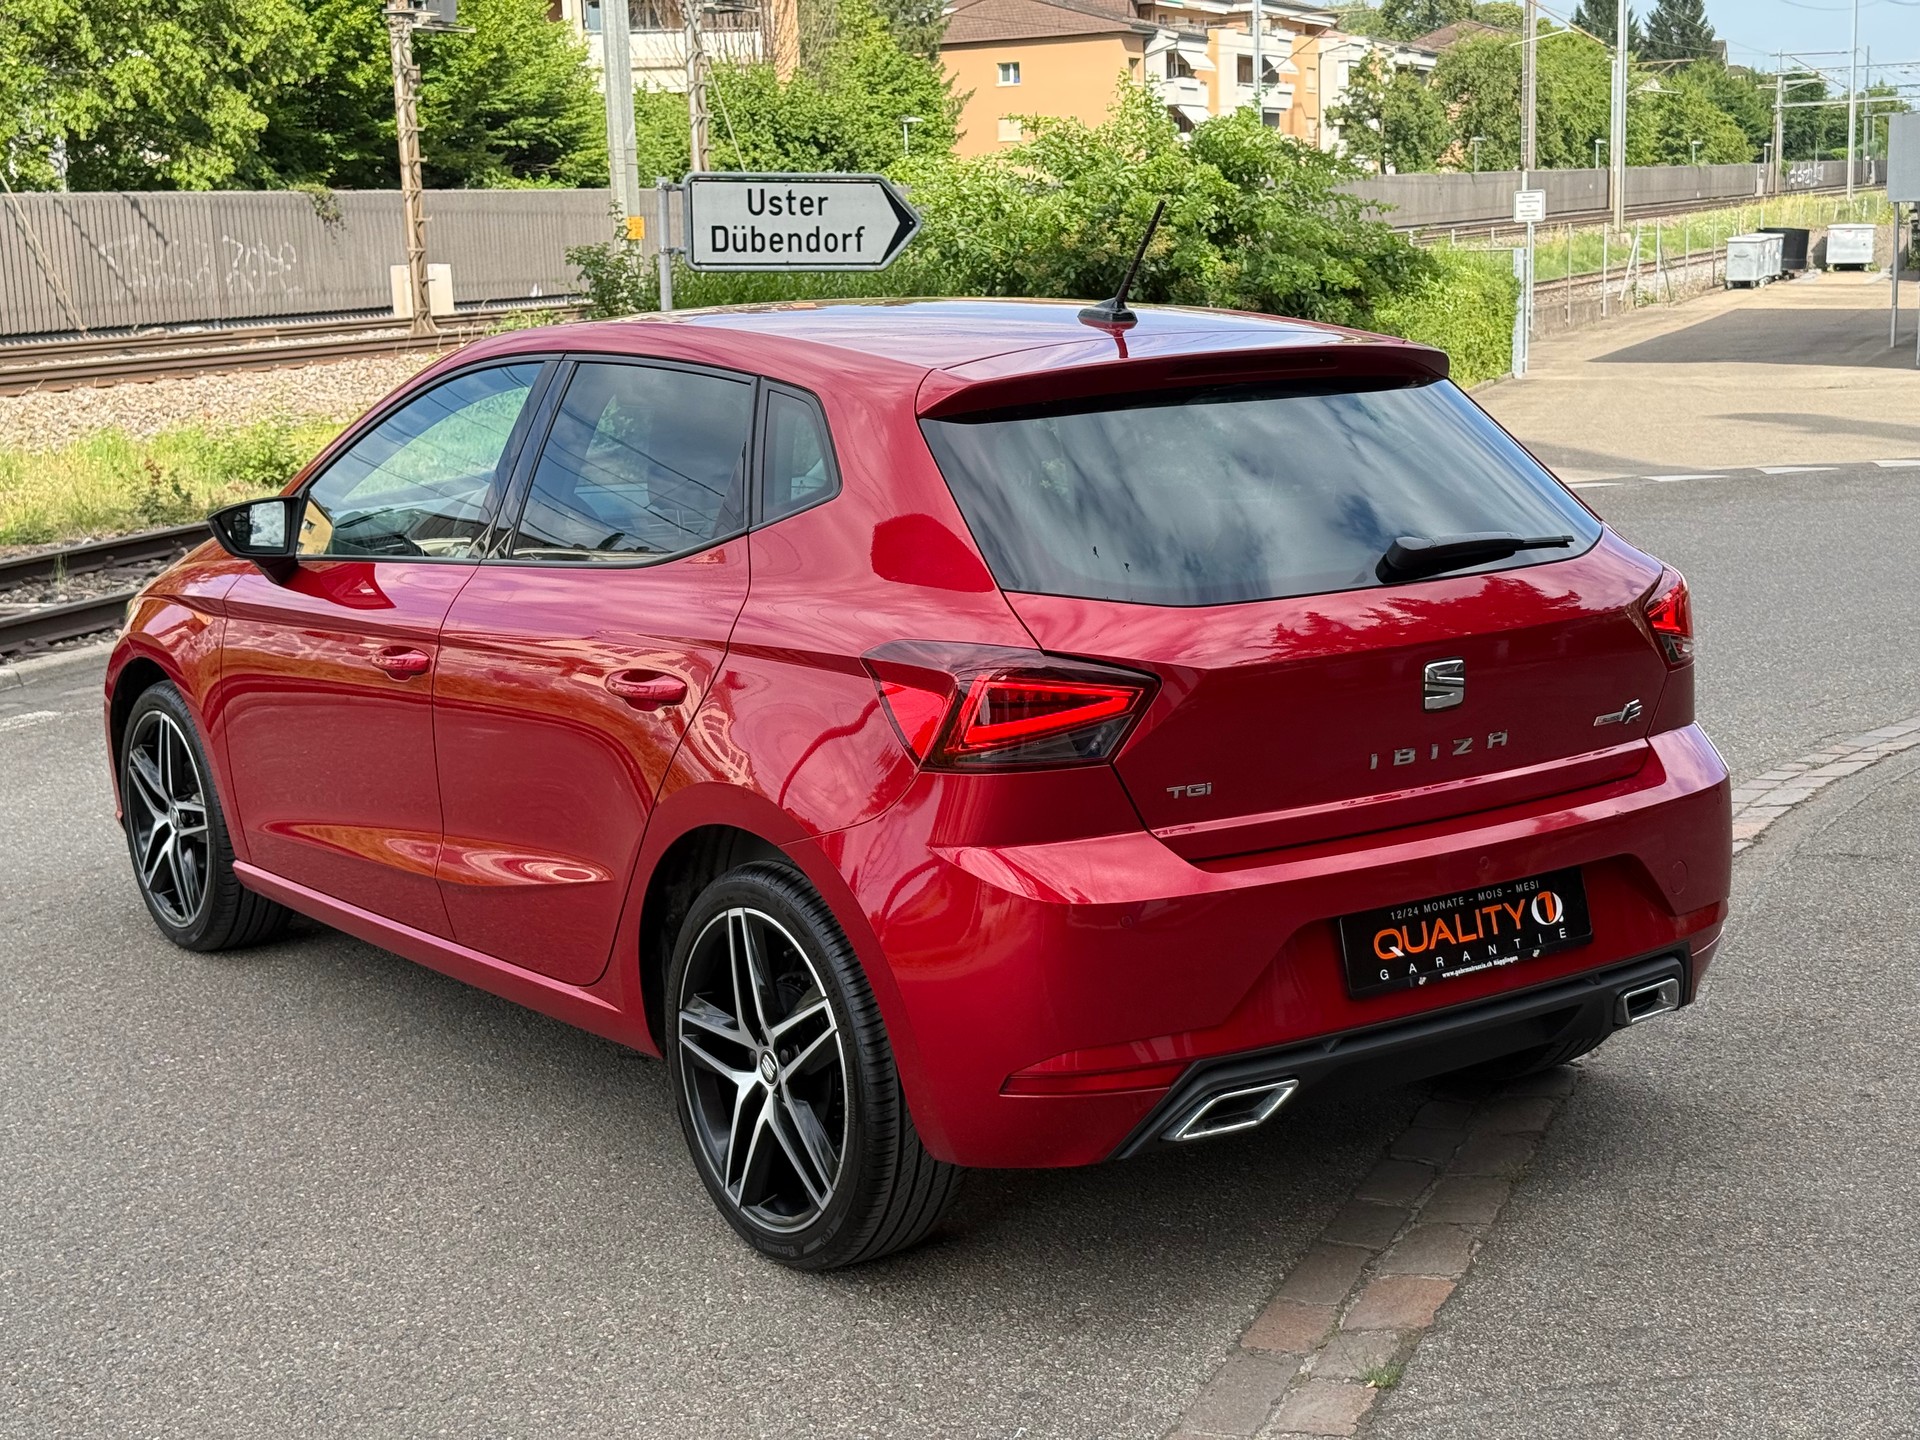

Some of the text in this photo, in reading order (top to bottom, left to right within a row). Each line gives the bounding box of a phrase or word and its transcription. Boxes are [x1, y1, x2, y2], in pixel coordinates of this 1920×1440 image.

[747, 187, 828, 216] Uster
[711, 225, 865, 253] Dübendorf
[1370, 729, 1509, 770] IBIZA
[1390, 908, 1419, 921] 12/24
[1423, 896, 1465, 914] MONATE
[1477, 888, 1503, 901] MOIS
[1515, 880, 1540, 893] MESI
[1373, 898, 1526, 960] QUALITY
[1379, 927, 1567, 981] GARANTIE
